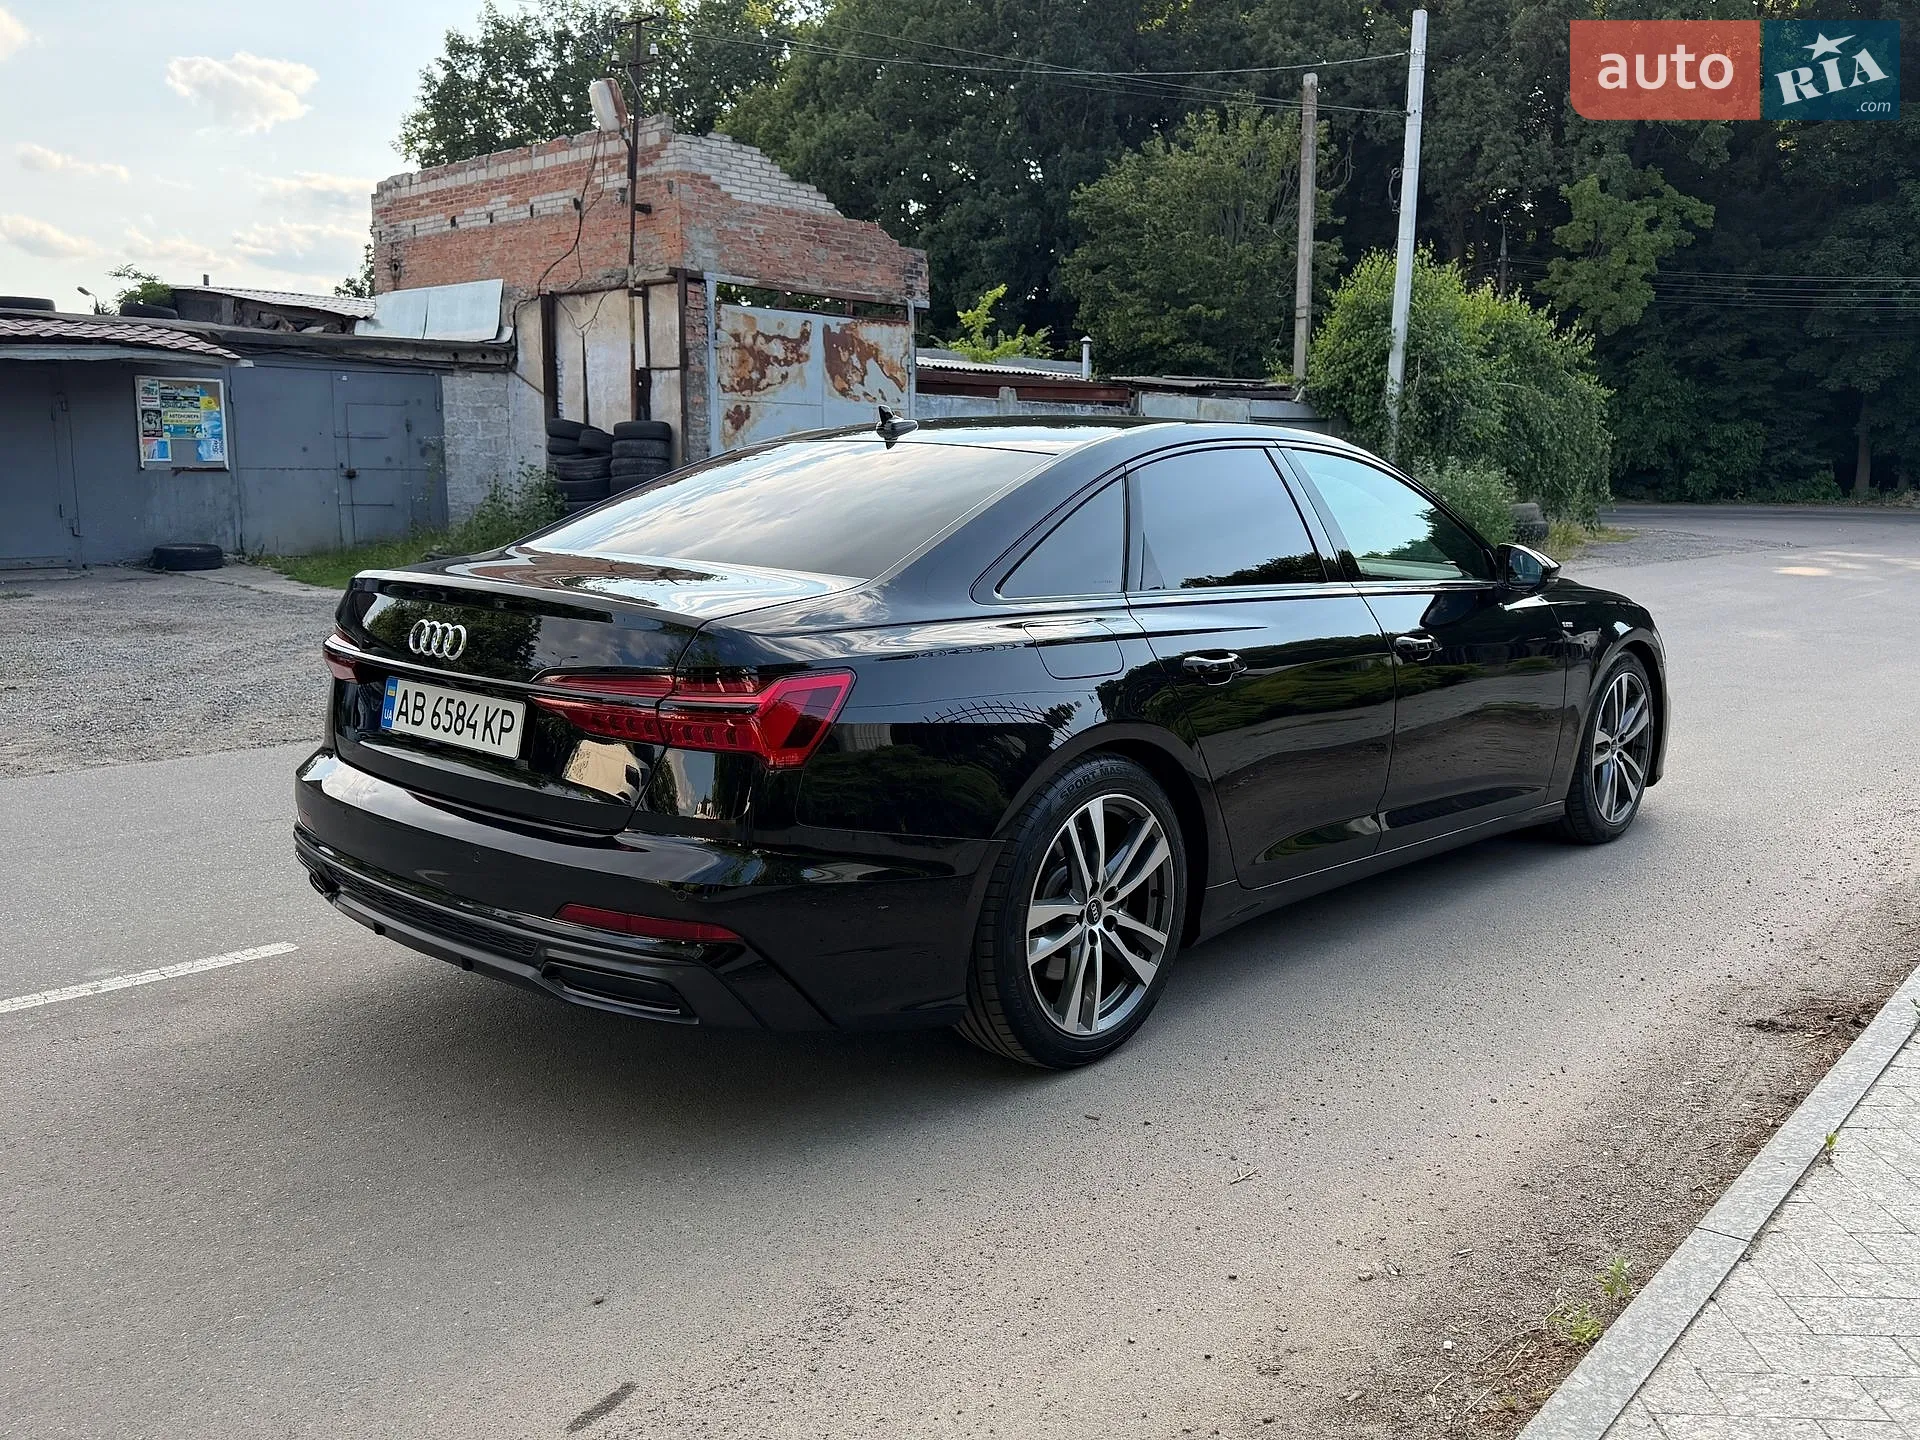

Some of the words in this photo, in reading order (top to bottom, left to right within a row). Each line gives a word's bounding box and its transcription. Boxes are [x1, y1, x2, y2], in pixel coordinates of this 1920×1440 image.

[384, 709, 392, 721] UA
[396, 689, 426, 726] AB
[431, 696, 480, 740] 6584
[482, 705, 515, 746] KP
[1059, 771, 1096, 799] SPORT
